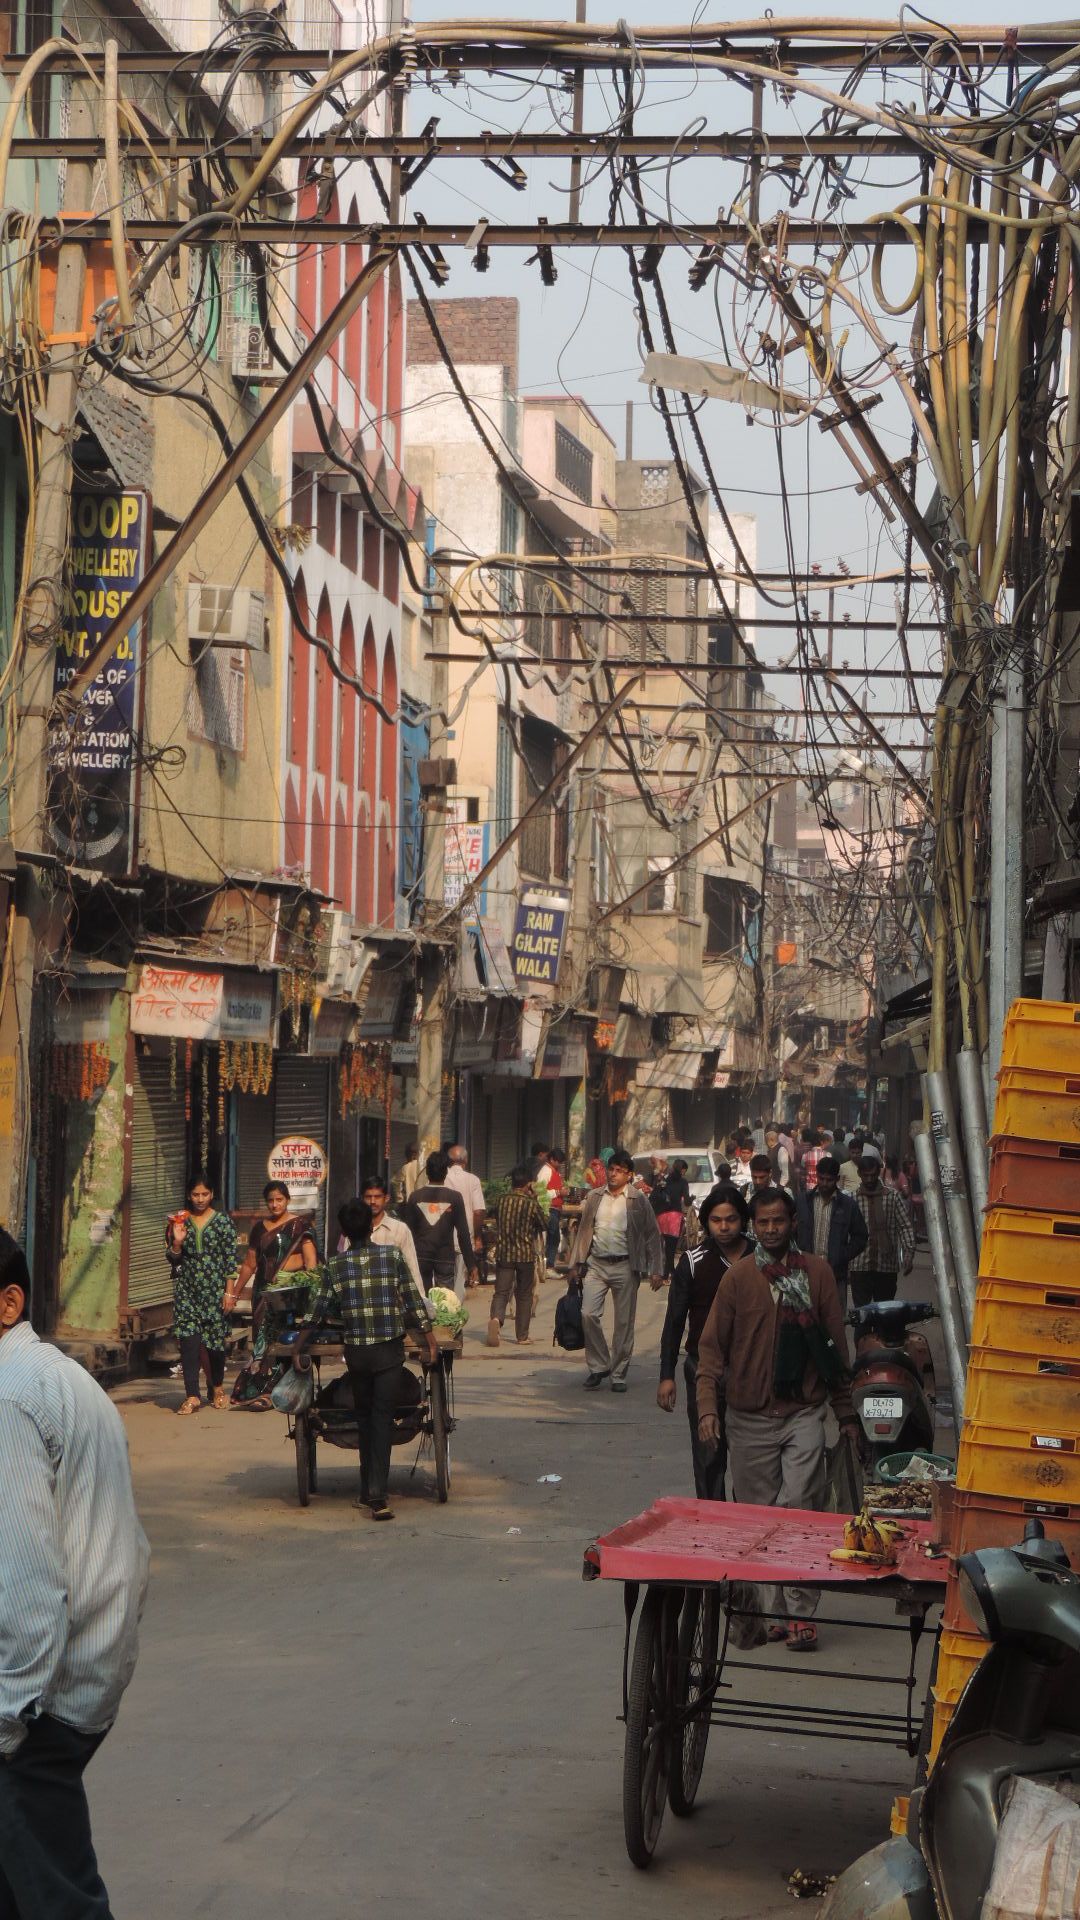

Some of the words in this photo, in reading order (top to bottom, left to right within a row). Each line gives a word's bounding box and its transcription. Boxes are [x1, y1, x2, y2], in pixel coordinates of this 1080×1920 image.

[72, 496, 139, 539] OOP
[107, 669, 127, 684] OF
[526, 912, 554, 931] RAM
[515, 933, 559, 956] GILATE
[516, 957, 550, 979] WALA
[281, 1144, 312, 1158] पुराना
